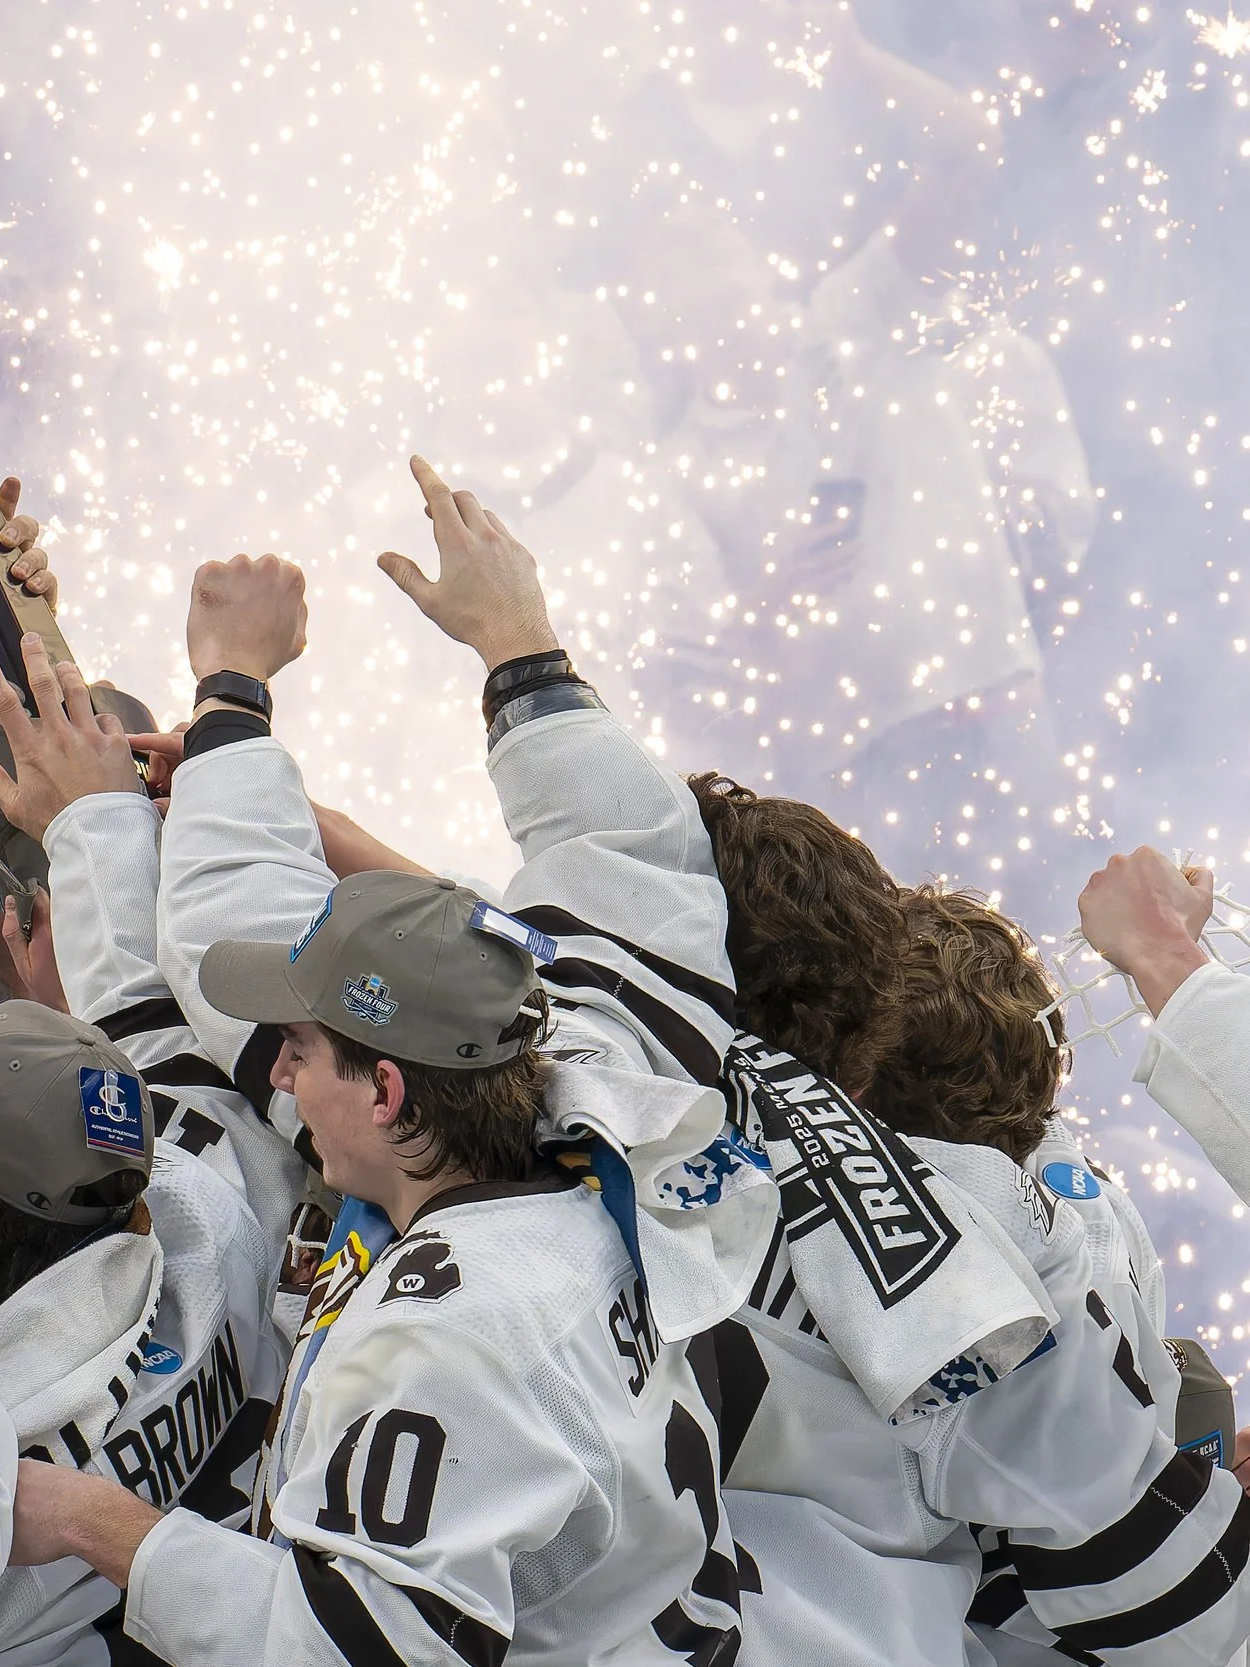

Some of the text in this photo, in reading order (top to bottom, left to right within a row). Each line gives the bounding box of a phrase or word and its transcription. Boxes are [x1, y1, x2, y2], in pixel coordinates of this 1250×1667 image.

[348, 986, 392, 1014] FROZEN FOUR
[769, 1072, 929, 1250] FROZEN
[786, 1114, 831, 1169] 2025
[402, 1278, 420, 1288] W
[140, 1349, 178, 1369] NCAA
[101, 1318, 245, 1508] BROWN
[315, 1407, 448, 1549] 10
